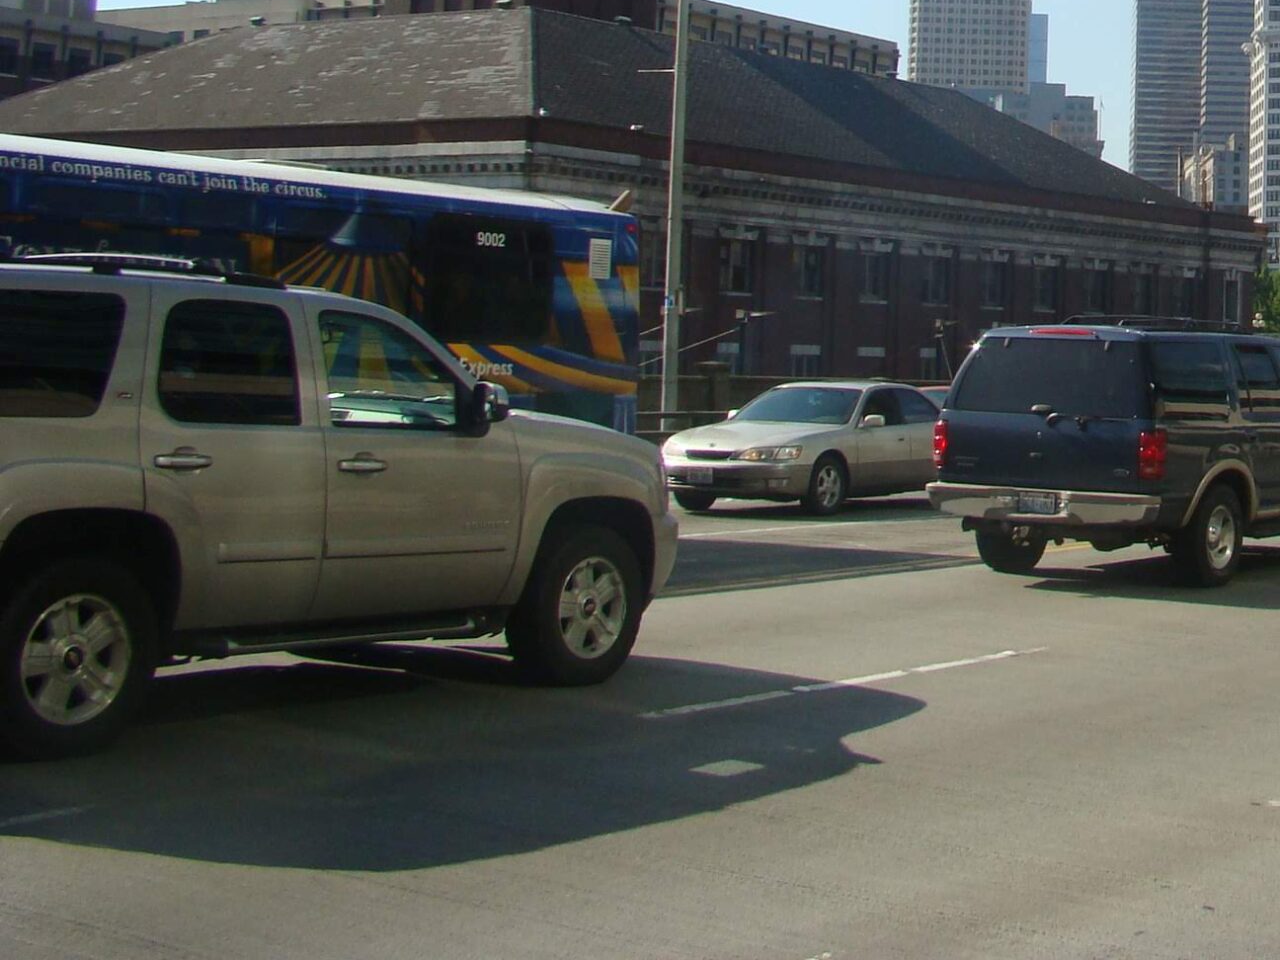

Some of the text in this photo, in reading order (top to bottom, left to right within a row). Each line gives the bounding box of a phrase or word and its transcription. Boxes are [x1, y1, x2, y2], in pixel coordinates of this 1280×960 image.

[52, 160, 152, 183] companies
[158, 170, 199, 186] can't
[203, 174, 237, 193] join
[243, 176, 269, 193] the
[275, 181, 327, 199] circus.
[477, 231, 506, 247] 9002
[459, 357, 514, 381] Express
